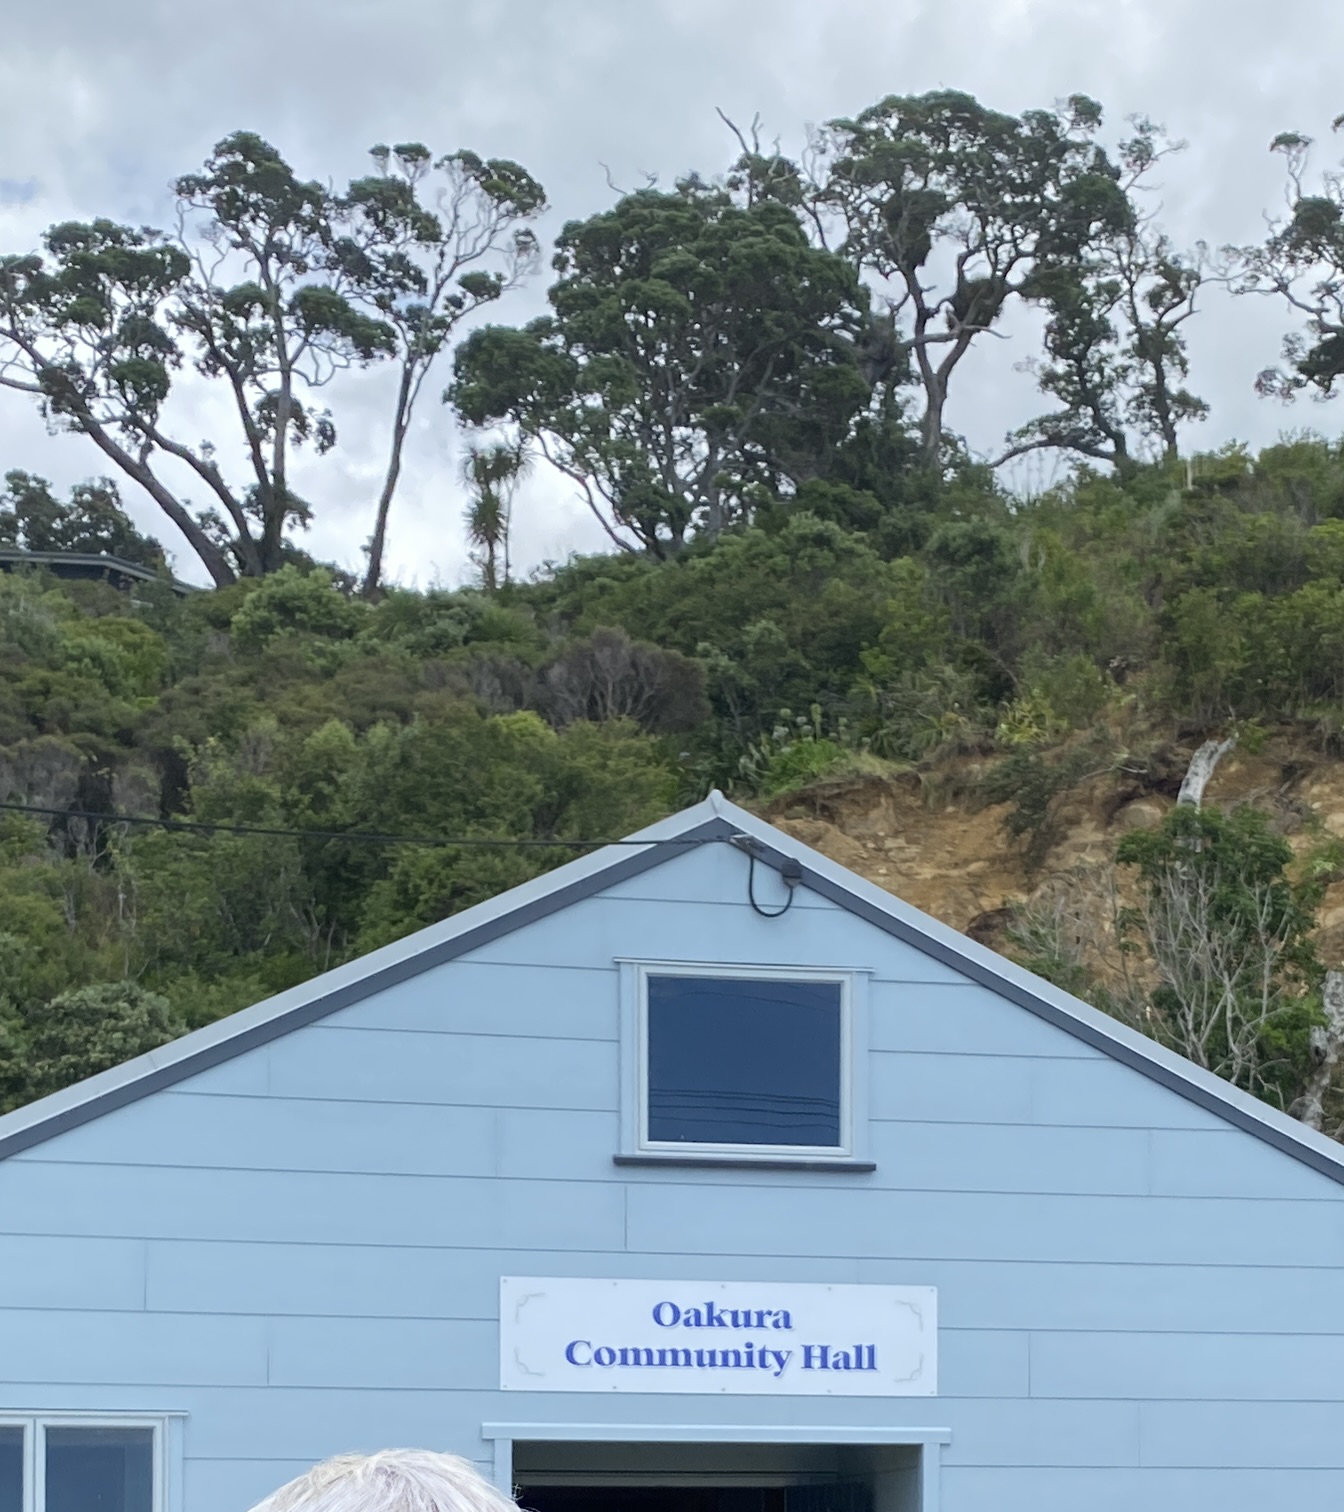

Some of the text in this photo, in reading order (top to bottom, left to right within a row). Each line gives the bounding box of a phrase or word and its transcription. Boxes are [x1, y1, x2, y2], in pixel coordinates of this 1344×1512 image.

[652, 1300, 793, 1330] Oakura
[565, 1339, 878, 1377] Community Hall
